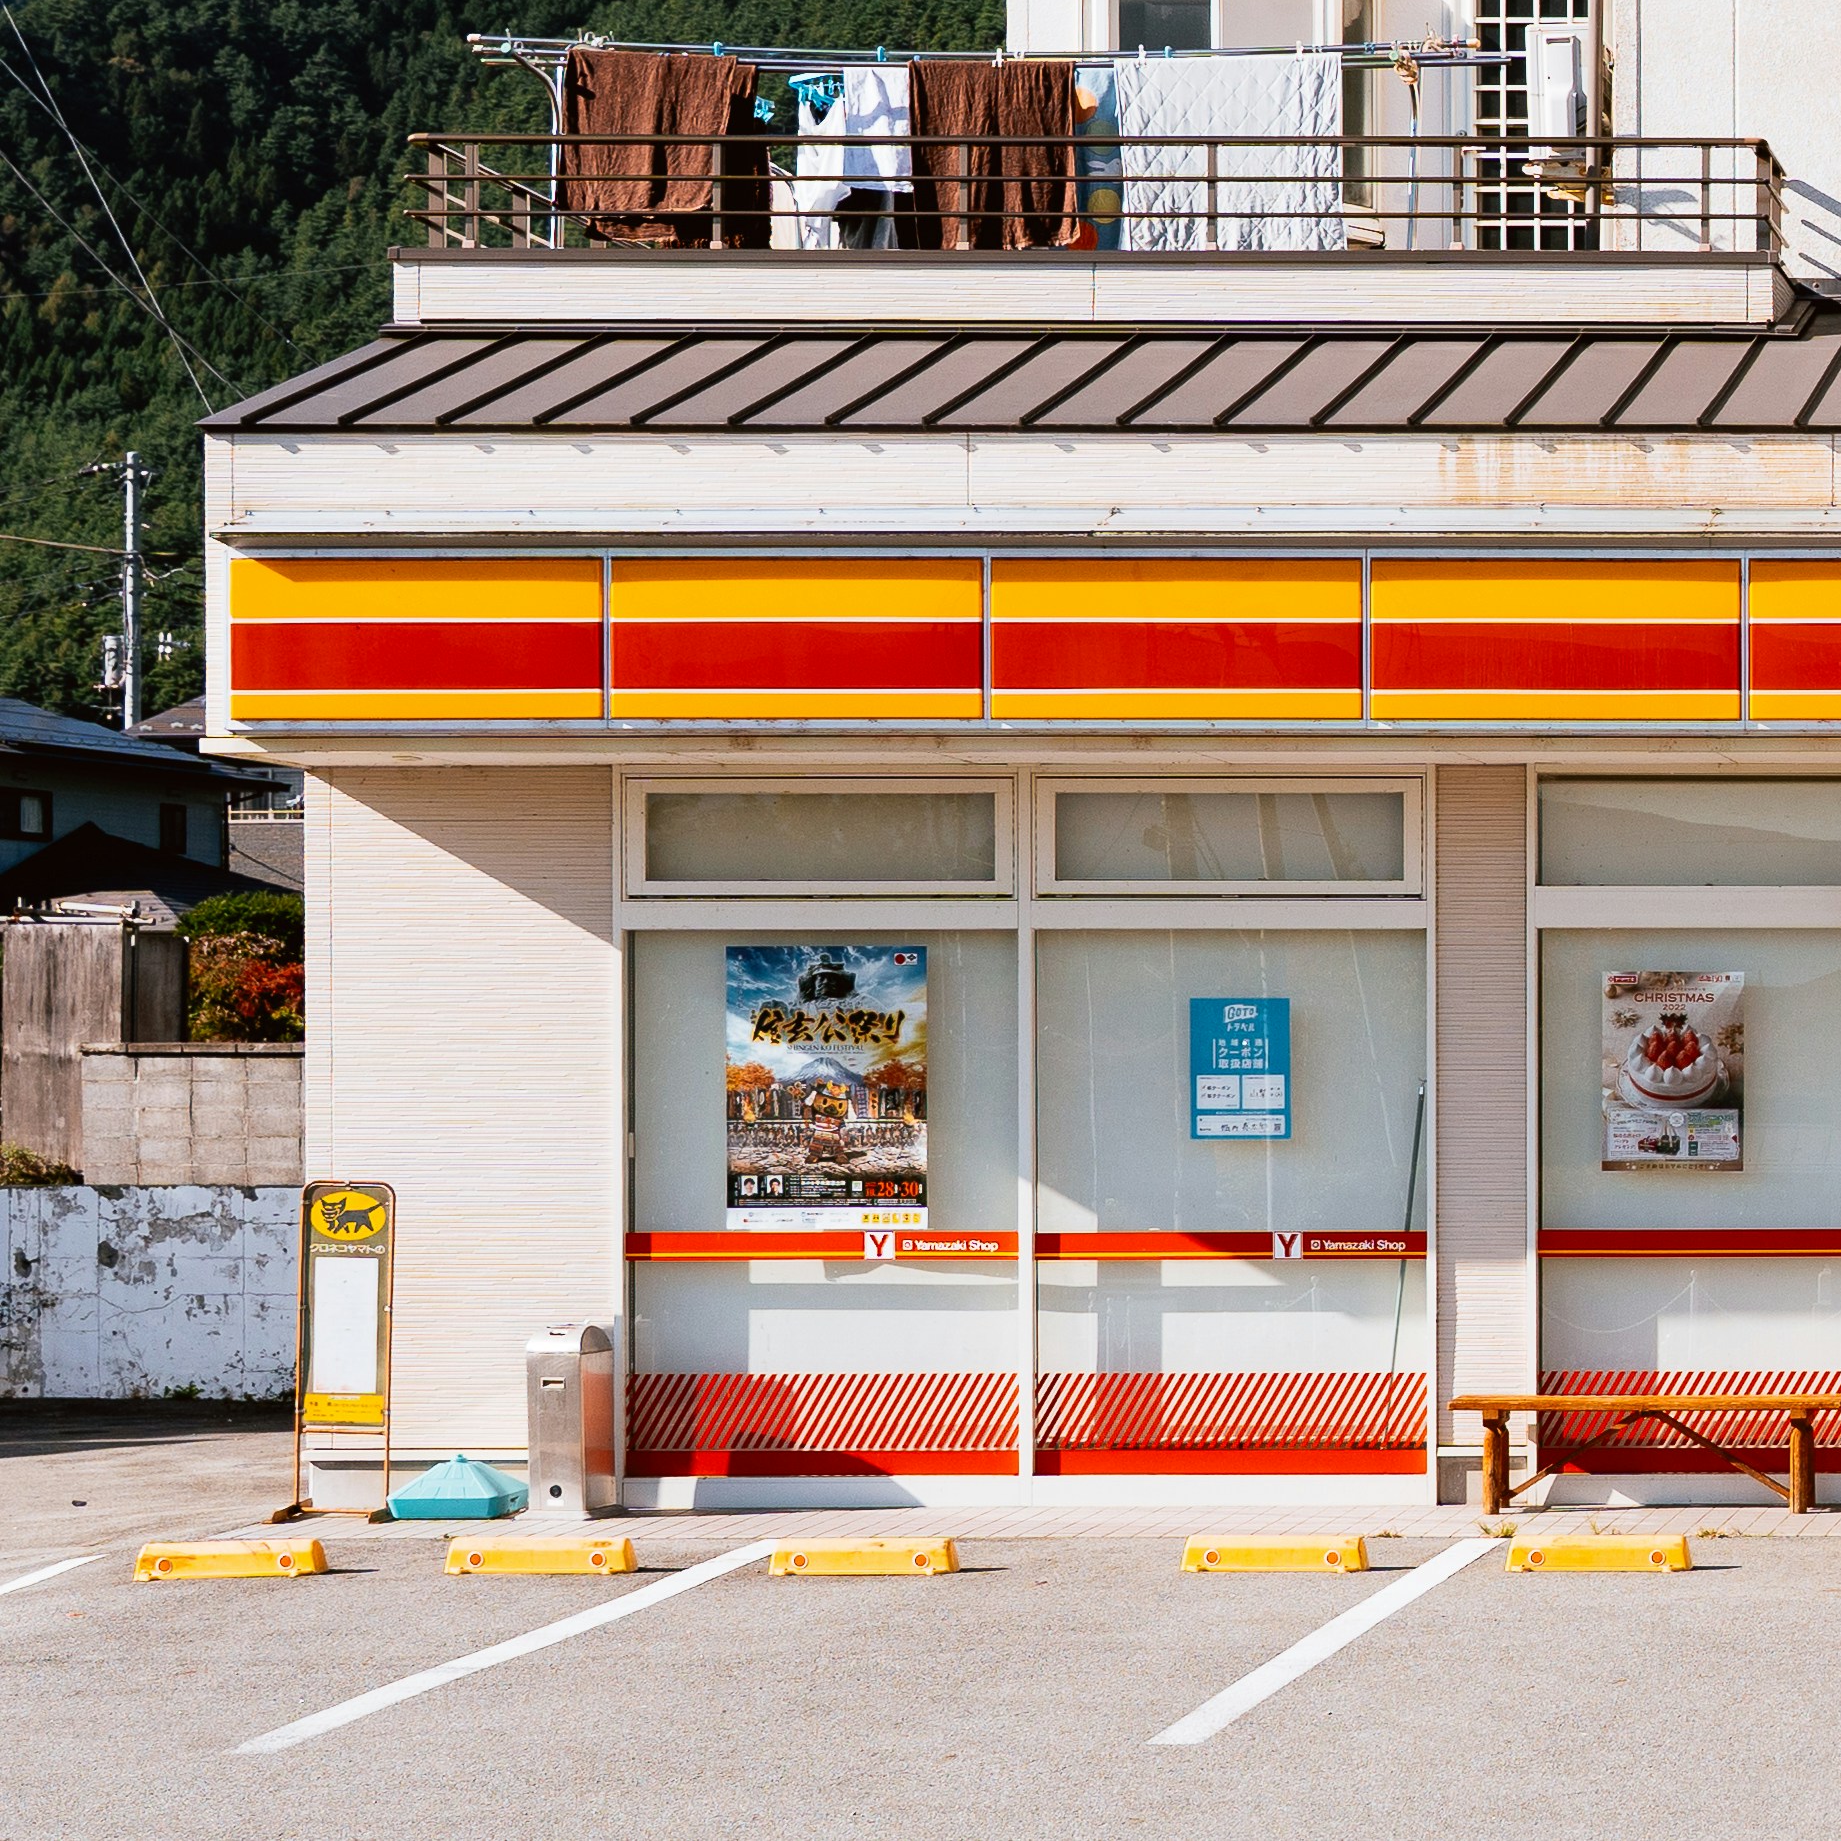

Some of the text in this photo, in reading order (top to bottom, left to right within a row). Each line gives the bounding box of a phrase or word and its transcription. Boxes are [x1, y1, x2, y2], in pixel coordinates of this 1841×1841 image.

[1634, 992, 1715, 1003] CHRISTMAS
[1226, 1022, 1255, 1032] トラベル
[1218, 1048, 1263, 1057] クーポン
[877, 1181, 894, 1197] 28
[901, 1181, 919, 1197] 30
[309, 1243, 386, 1254] クロネコヤマトの
[869, 1234, 999, 1257] Y Yamazaki Shop
[1276, 1233, 1406, 1257] Y Yamazaki Shop
